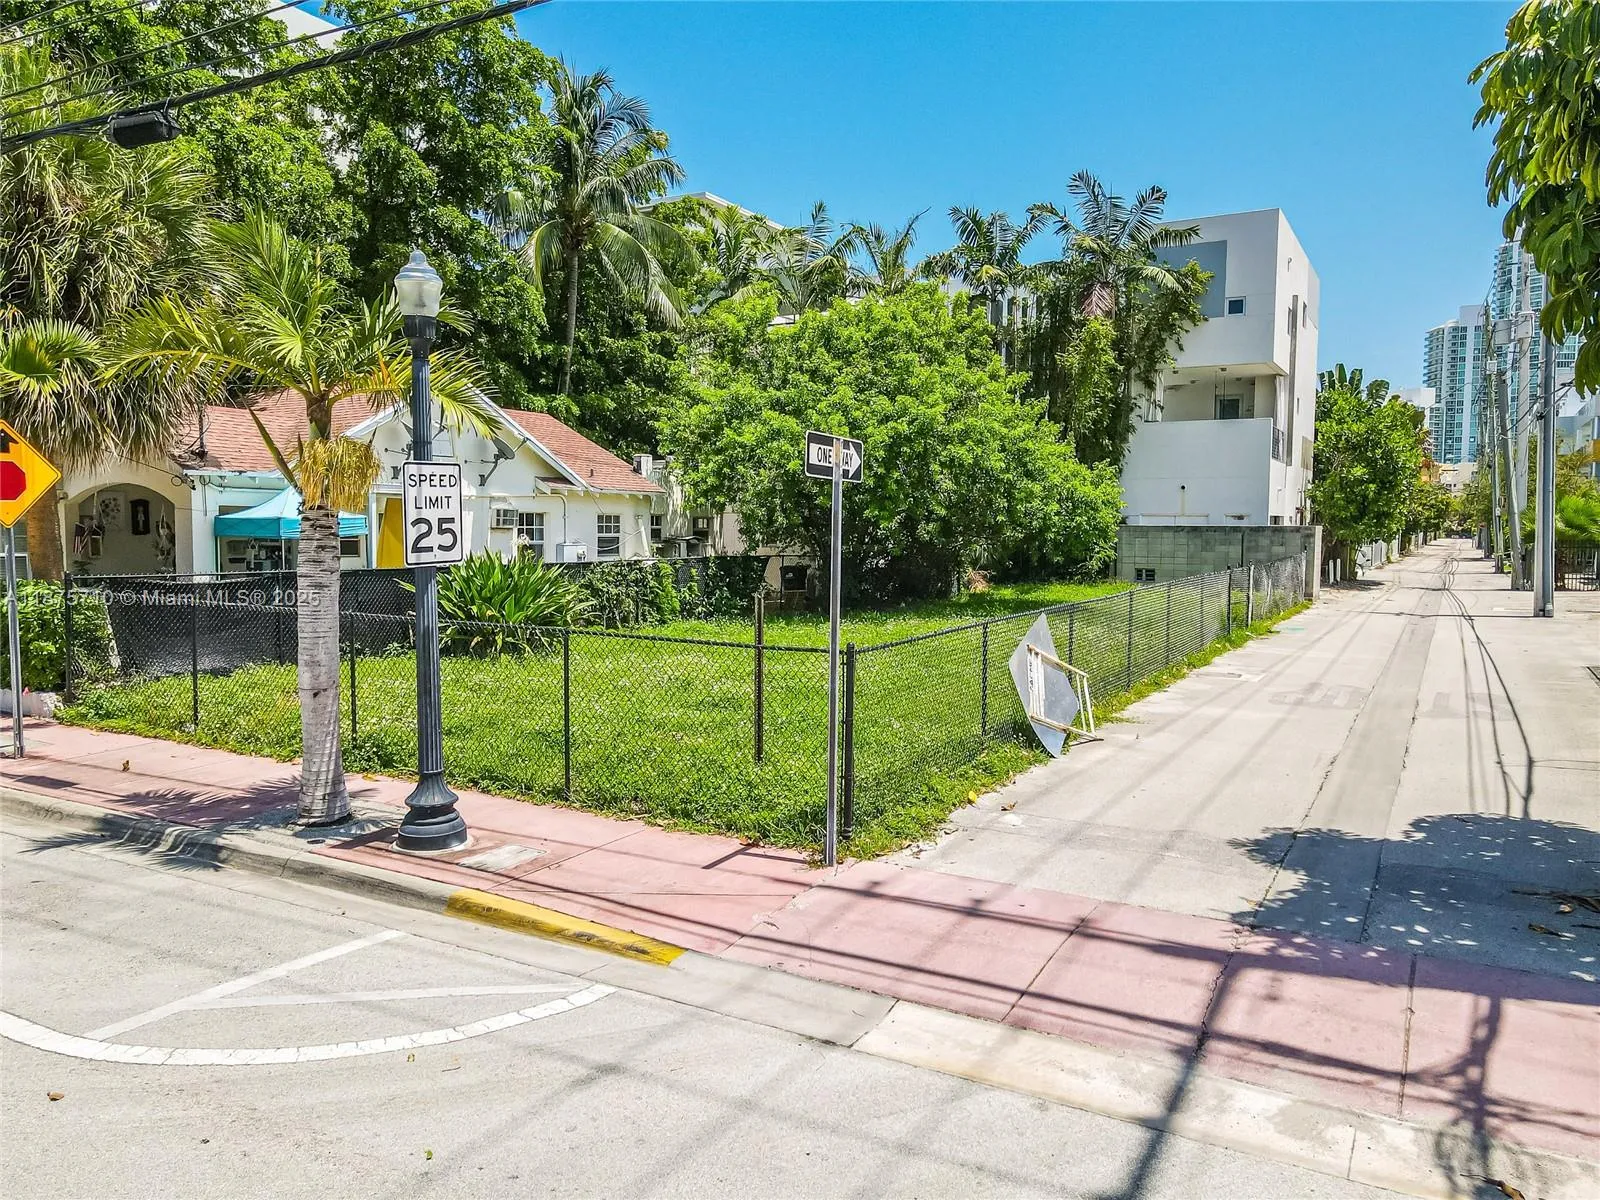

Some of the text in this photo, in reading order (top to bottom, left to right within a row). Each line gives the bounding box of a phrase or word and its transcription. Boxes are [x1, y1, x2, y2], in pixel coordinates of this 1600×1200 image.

[816, 446, 832, 464] ONE
[408, 473, 457, 488] SPEED
[414, 495, 452, 510] LIMIT
[410, 517, 458, 554] 25
